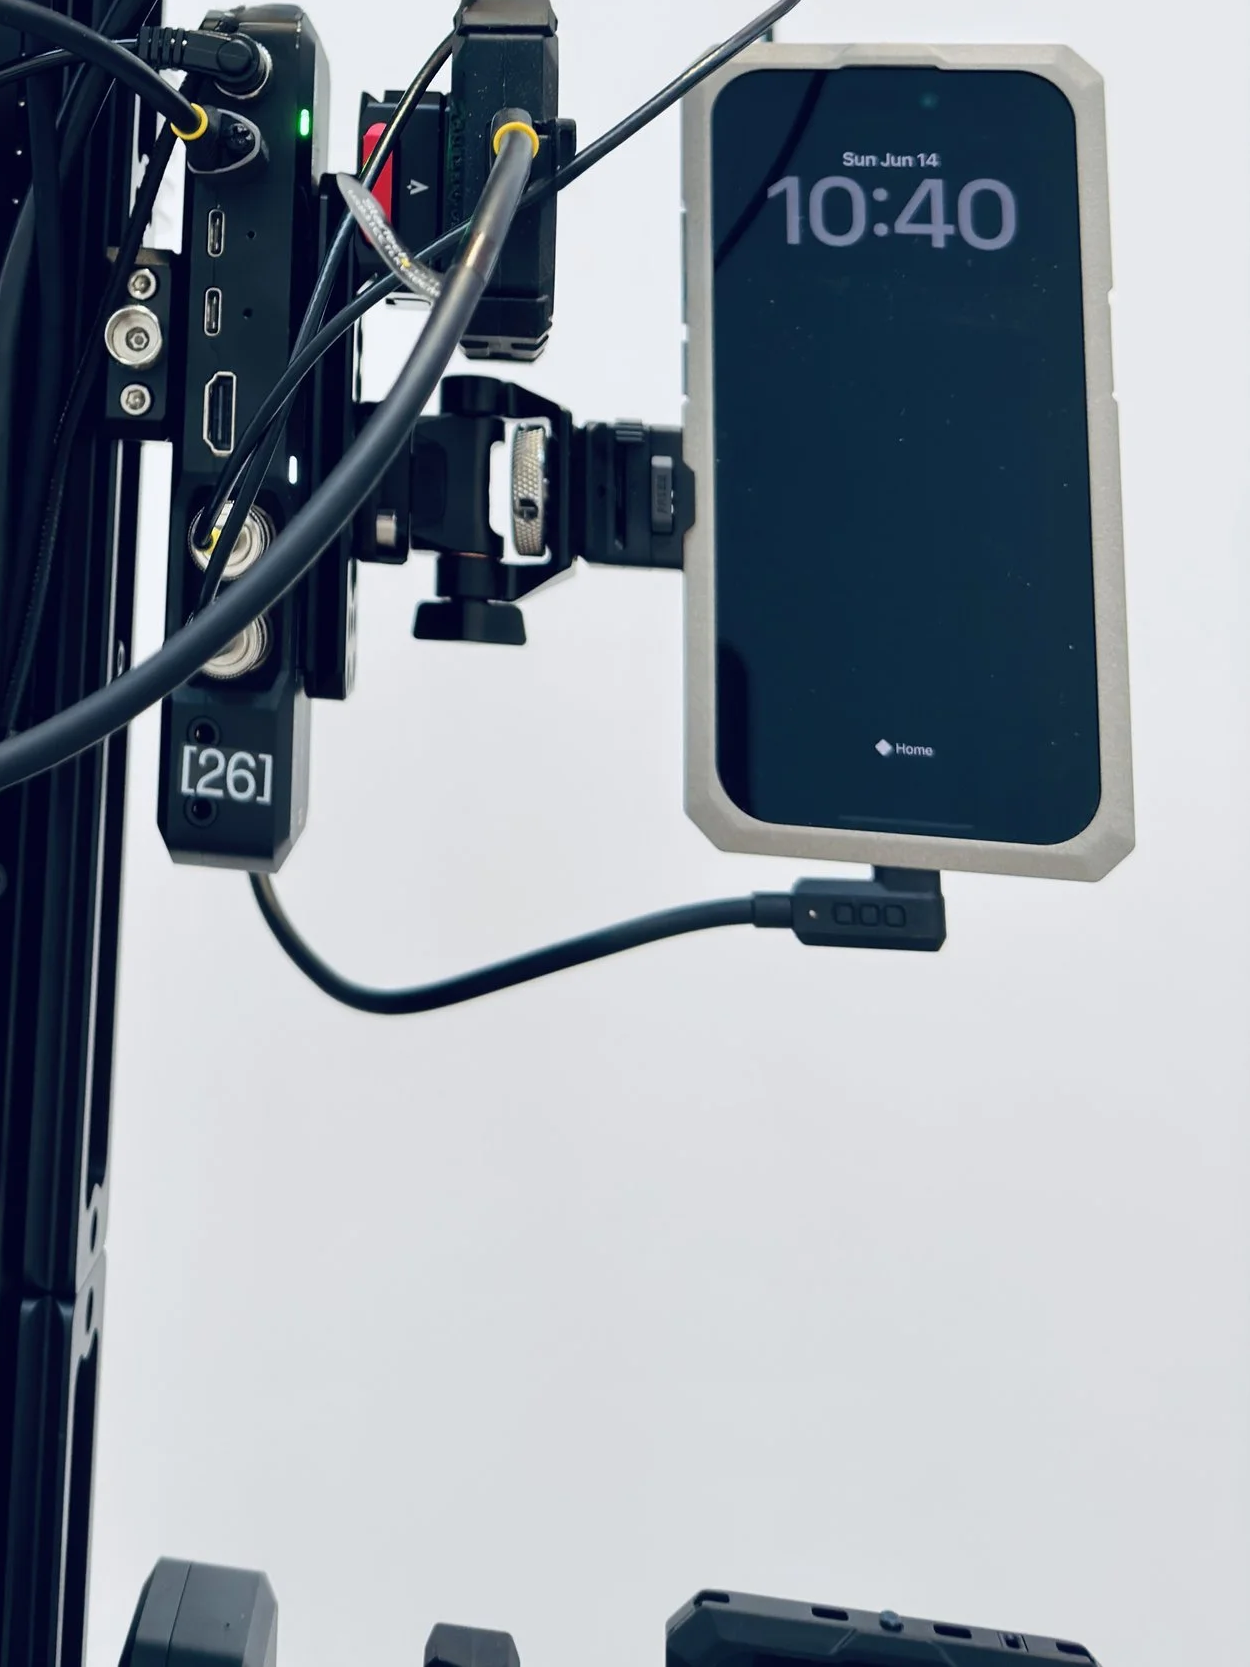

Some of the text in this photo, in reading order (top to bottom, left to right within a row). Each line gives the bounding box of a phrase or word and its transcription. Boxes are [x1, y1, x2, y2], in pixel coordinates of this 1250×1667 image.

[842, 151, 940, 168] Sun Jun 14
[767, 175, 1018, 251] 10:40
[895, 742, 934, 757] Home
[180, 744, 273, 805] [26]
